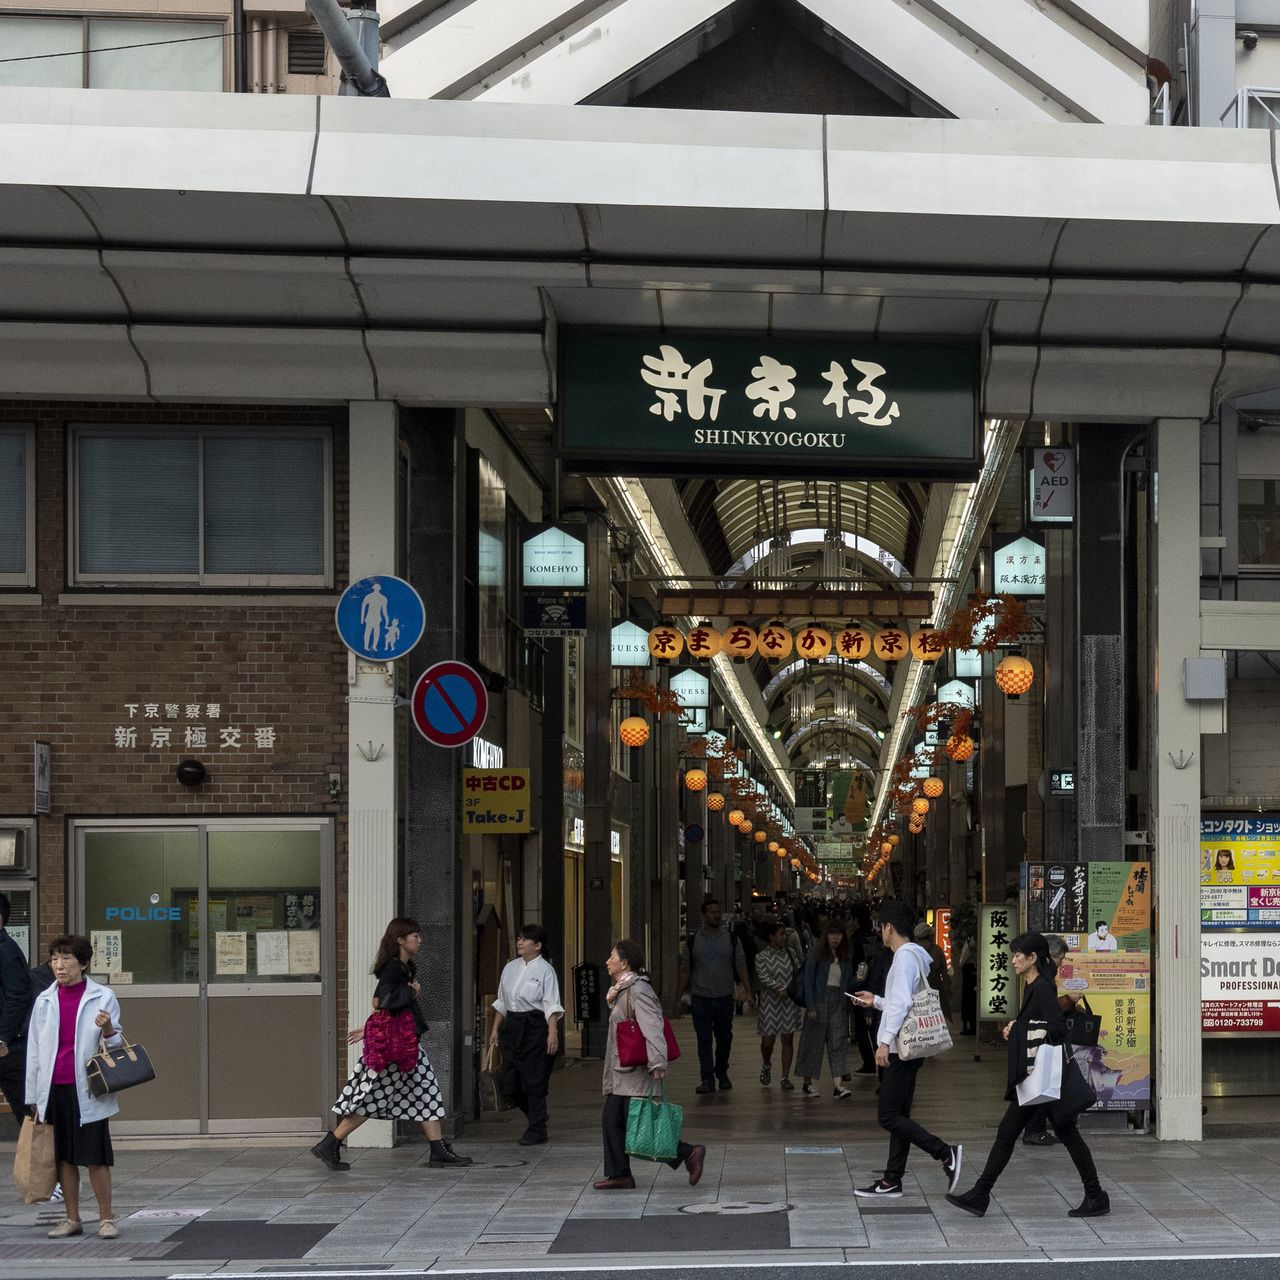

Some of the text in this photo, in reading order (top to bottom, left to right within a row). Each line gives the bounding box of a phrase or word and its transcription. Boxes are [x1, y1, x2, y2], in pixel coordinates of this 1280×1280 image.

[640, 344, 901, 426] 新京極
[694, 428, 846, 449] SHINKYOGOKU
[1040, 476, 1069, 487] AED
[529, 565, 579, 573] KOMEHYO
[124, 703, 222, 719] 下京警察署
[114, 726, 277, 749] 新京極交番
[465, 775, 526, 792] 中古CD
[466, 798, 481, 807] 3F
[105, 907, 182, 921] POLICE
[988, 910, 1010, 1015] 阪本漢方堂
[1200, 957, 1257, 978] Smart
[1114, 999, 1124, 1047] 御朱印めぐり
[1126, 1016, 1137, 1048] 新京極
[1214, 1018, 1264, 1027] 0120-733799
